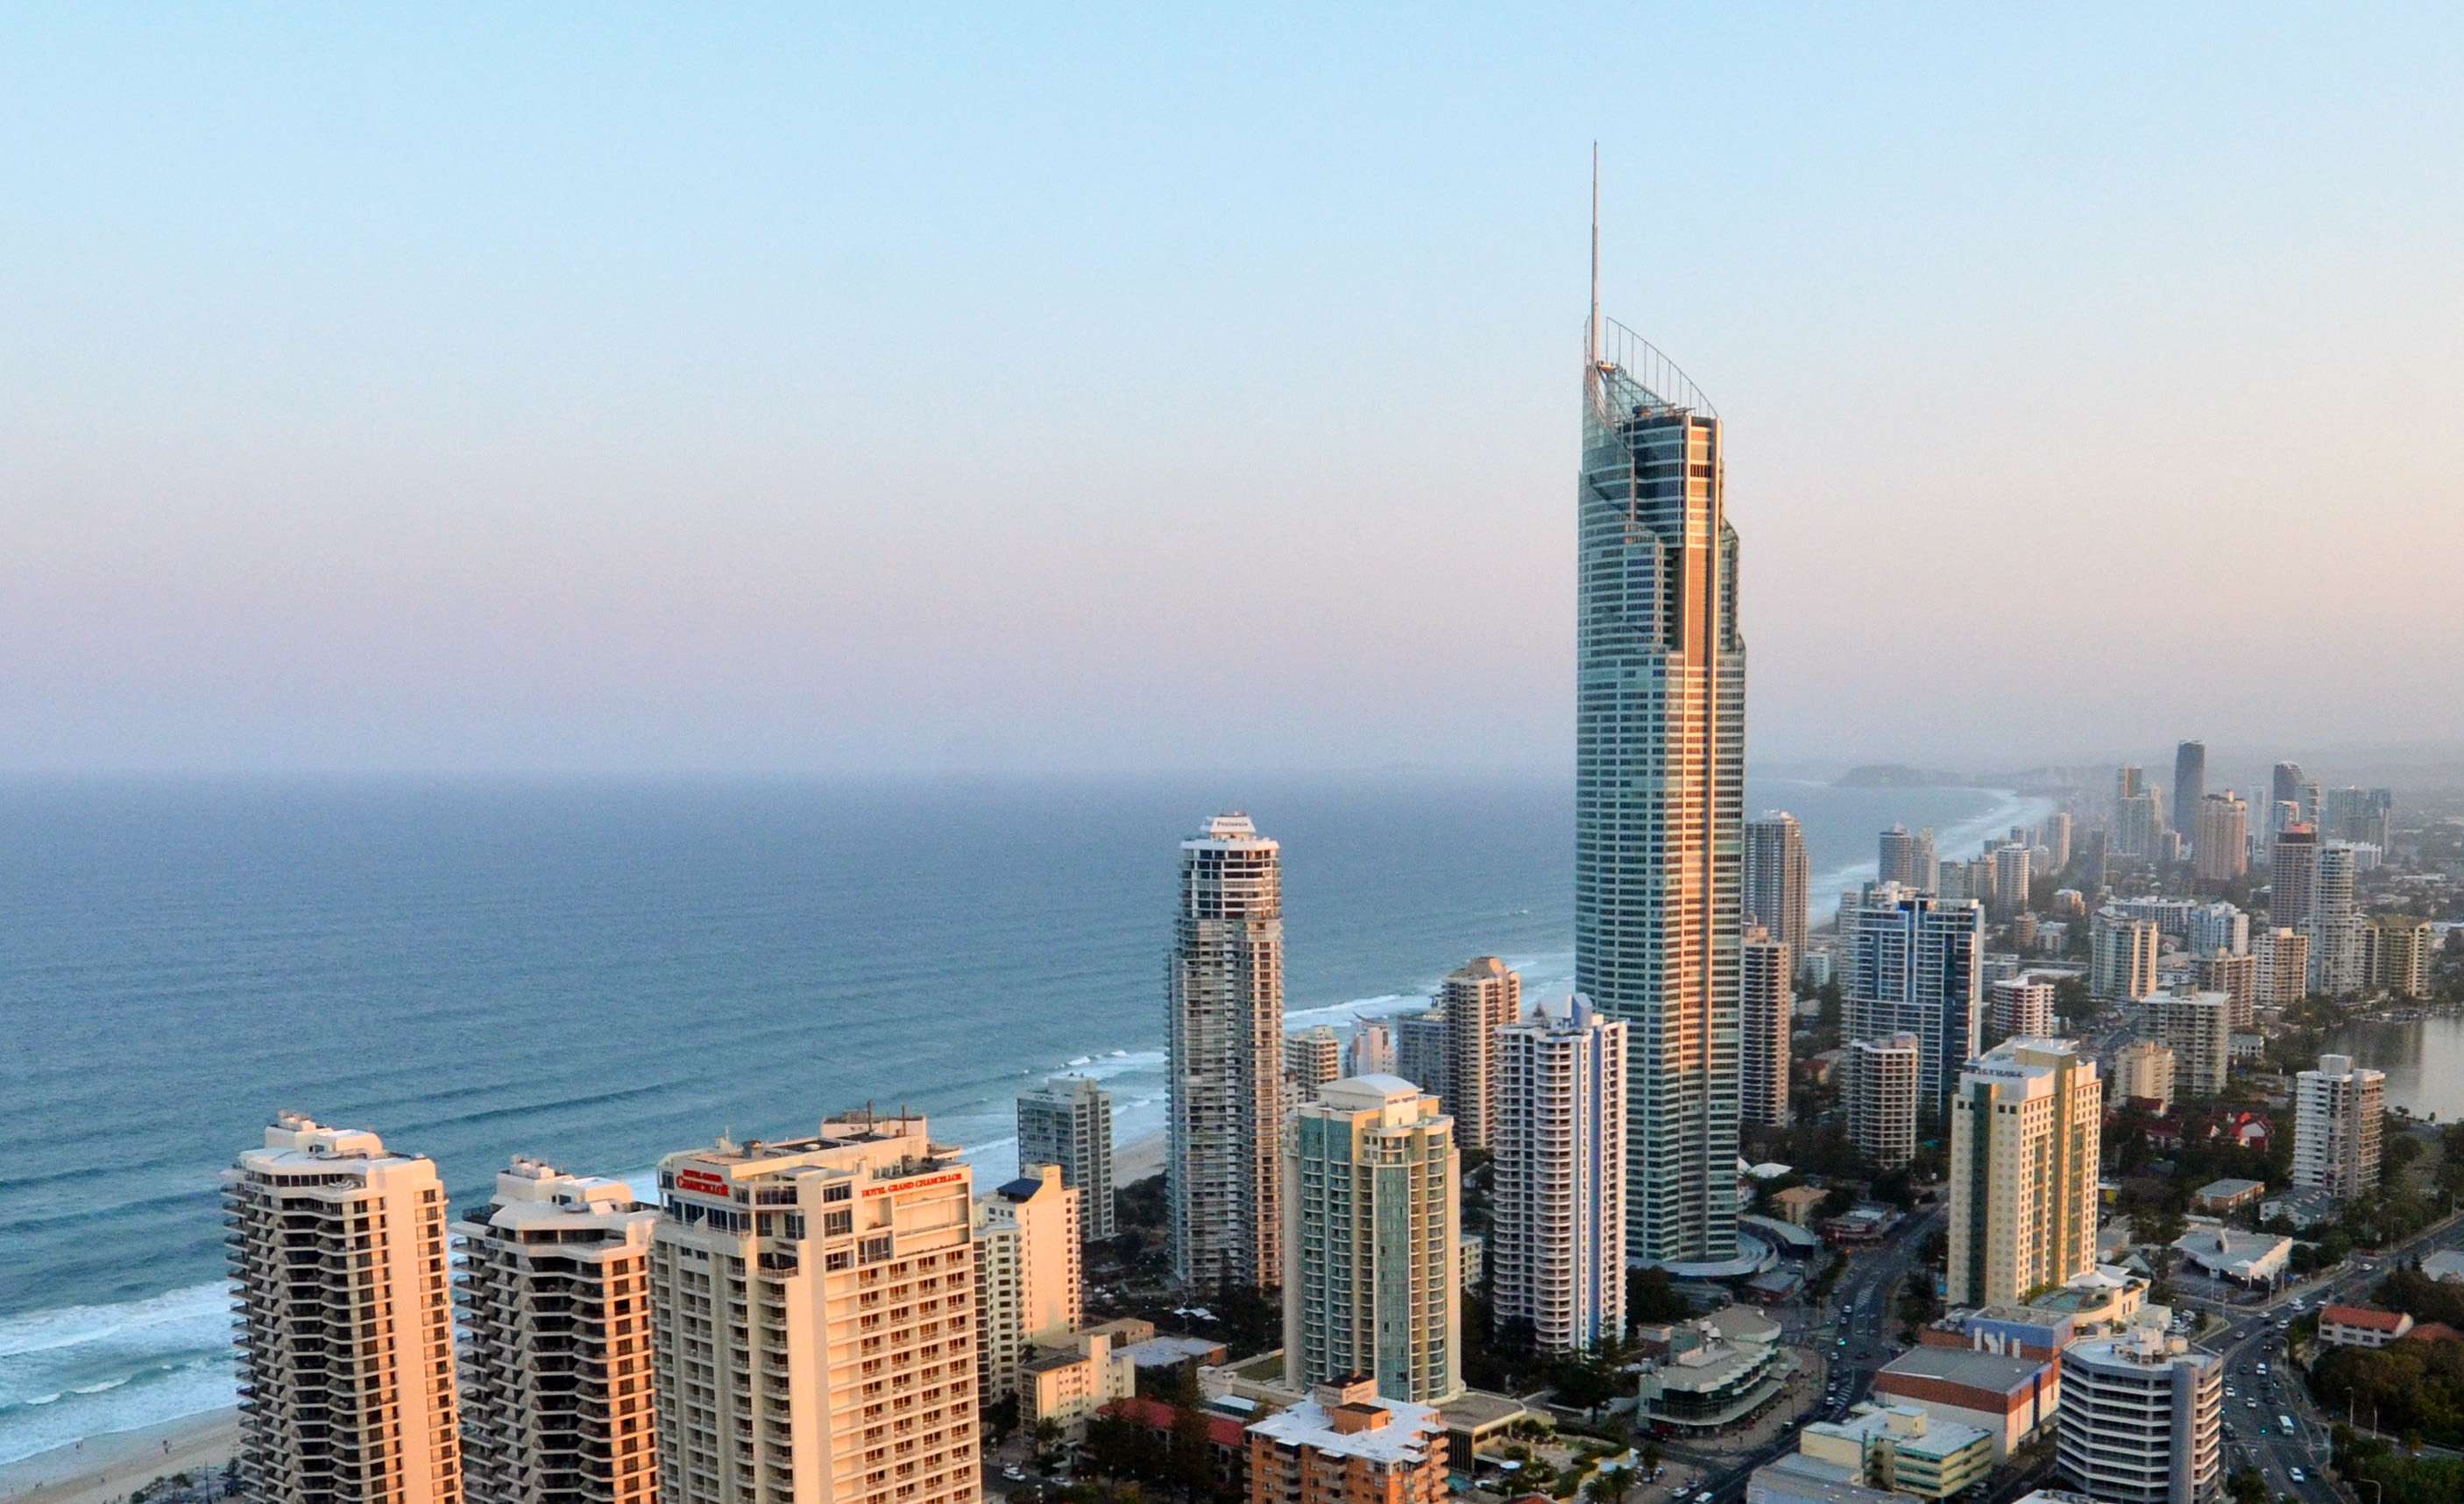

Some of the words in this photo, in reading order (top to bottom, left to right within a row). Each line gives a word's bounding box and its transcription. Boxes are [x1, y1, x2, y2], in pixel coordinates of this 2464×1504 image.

[676, 1174, 730, 1197] CHANCELLOR
[862, 1187, 885, 1197] HOTEL
[888, 1181, 914, 1192] GRAND
[915, 1173, 961, 1188] CHANCELLOR
